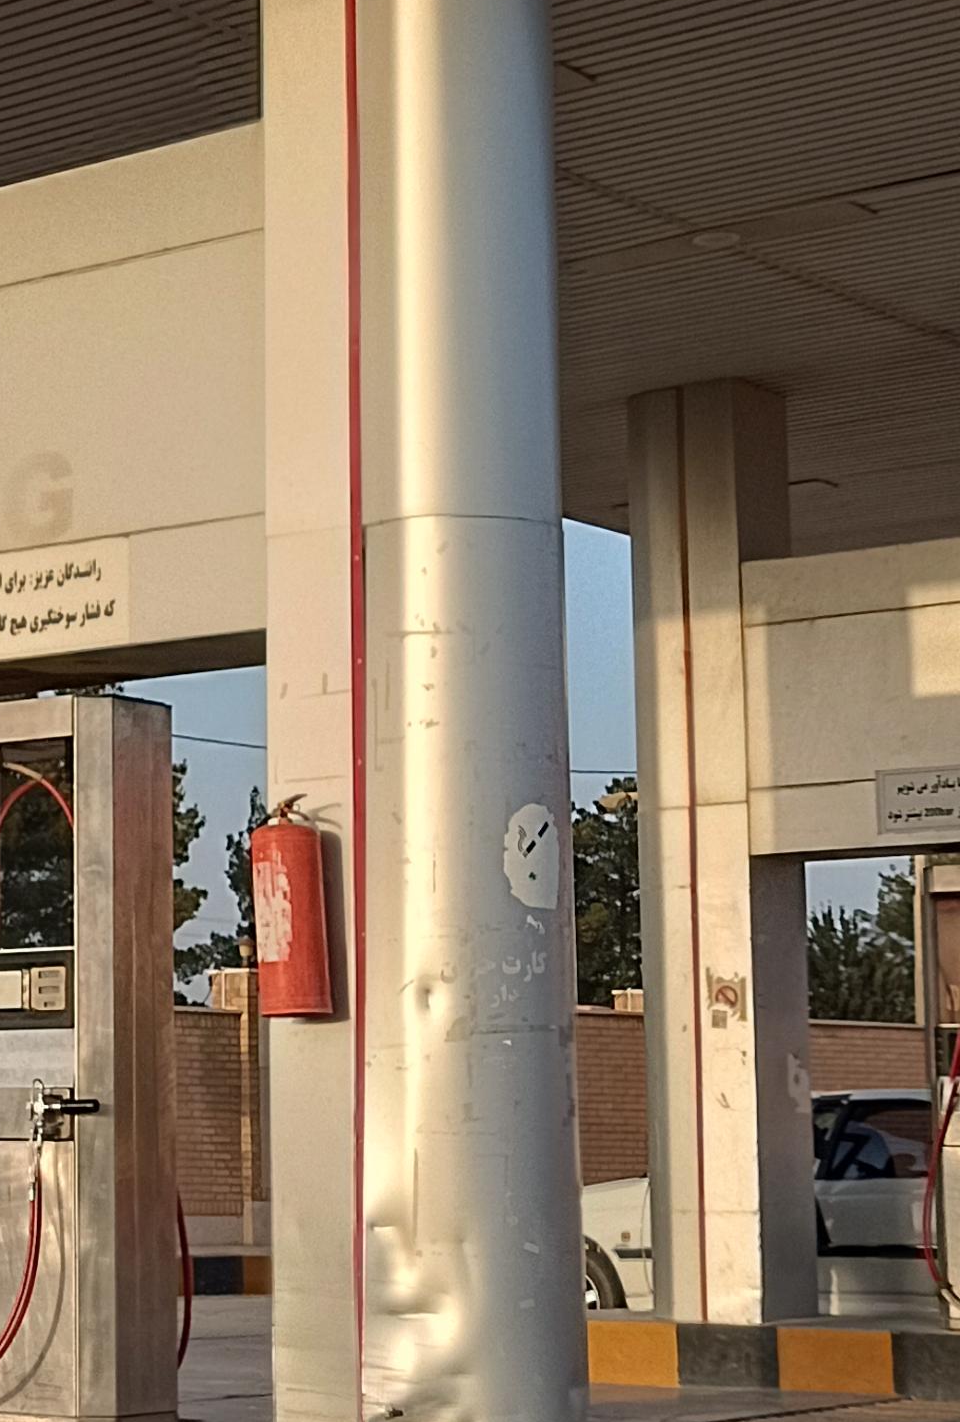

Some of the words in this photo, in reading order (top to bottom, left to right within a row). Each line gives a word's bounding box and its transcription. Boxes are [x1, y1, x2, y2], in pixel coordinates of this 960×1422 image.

[5, 570, 26, 594] برای
[79, 599, 101, 627] فشار
[10, 615, 26, 636] هیچ
